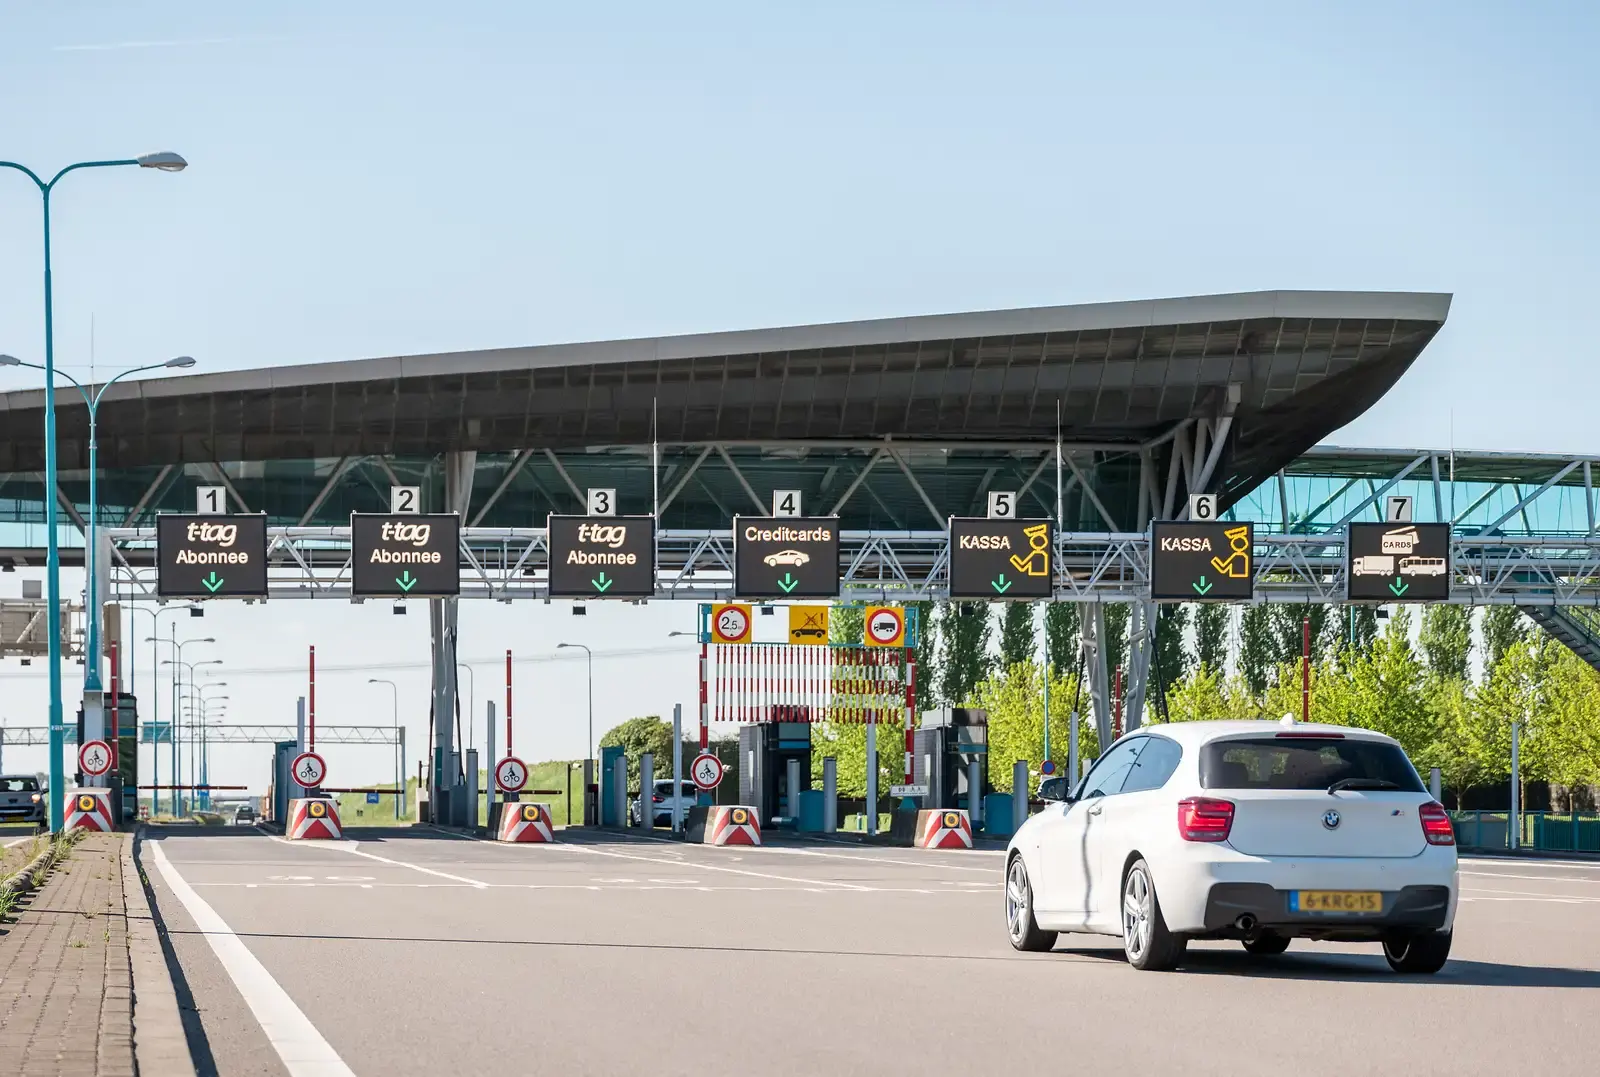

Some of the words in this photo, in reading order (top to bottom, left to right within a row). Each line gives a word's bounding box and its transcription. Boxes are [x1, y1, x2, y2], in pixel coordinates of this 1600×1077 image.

[206, 489, 217, 512] 1
[398, 489, 413, 512] 2
[594, 491, 609, 514] 3
[779, 492, 796, 514] 4
[995, 494, 1010, 517] 5
[1196, 496, 1211, 519] 6
[1393, 498, 1407, 520] 7
[186, 522, 238, 547] t-tag
[381, 521, 431, 547] t-tag
[577, 523, 627, 548] t-tag
[745, 526, 832, 542] Creditcards
[959, 535, 1011, 550] KASSA
[1161, 537, 1212, 552] KASSA
[1383, 541, 1412, 549] CARDS
[175, 549, 249, 565] Abonnee
[370, 548, 442, 564] Abonnee
[567, 550, 637, 565] Abonnee
